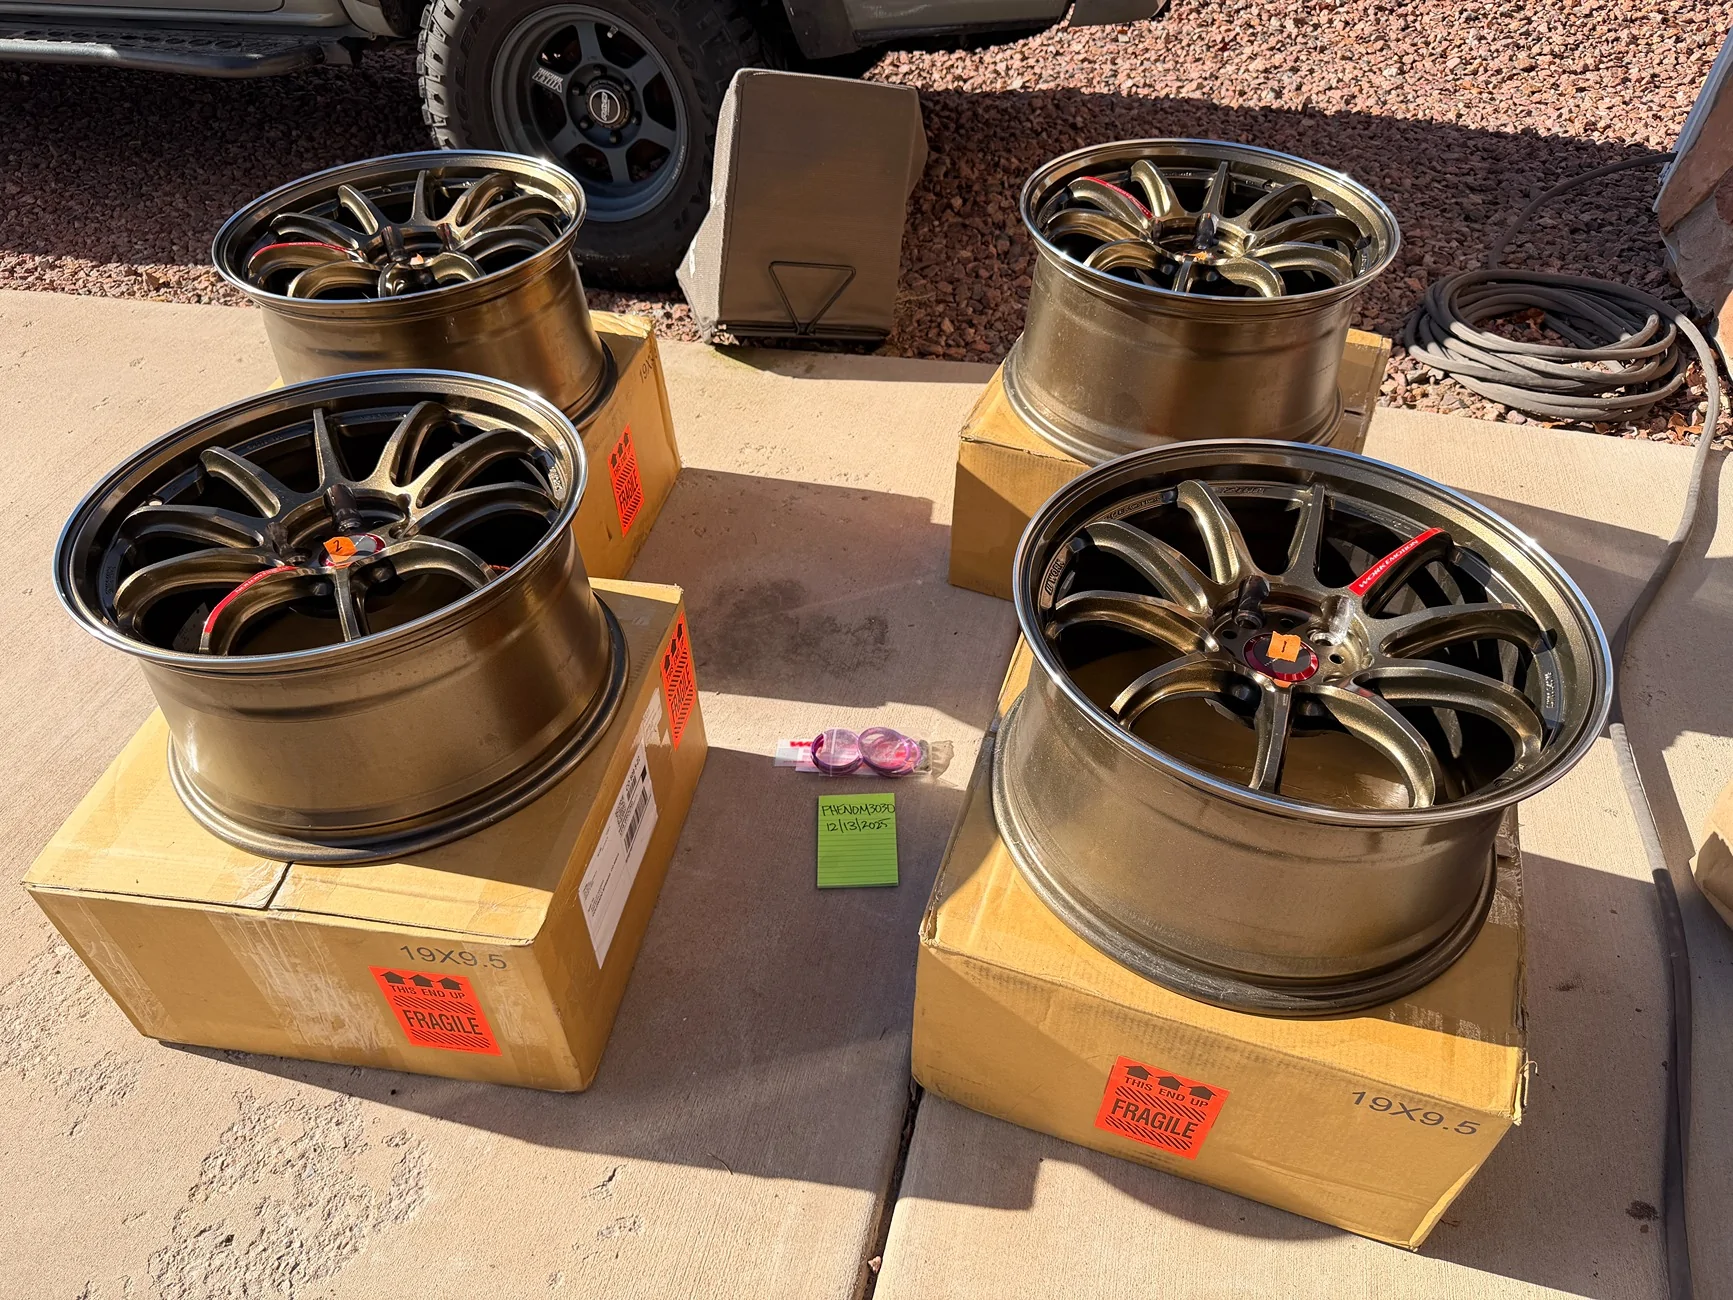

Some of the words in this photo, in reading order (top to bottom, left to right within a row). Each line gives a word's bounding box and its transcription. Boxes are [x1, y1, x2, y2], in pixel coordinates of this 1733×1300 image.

[332, 539, 343, 552] 2
[1358, 564, 1387, 588] WORK
[1385, 539, 1419, 566] EMOTION
[670, 663, 691, 724] FRAGILE
[821, 803, 896, 817] PHENOM3030
[826, 817, 891, 834] 12/13/2025
[400, 945, 507, 970] 19X9.5
[389, 985, 417, 995] THIS
[421, 988, 446, 998] END
[449, 991, 466, 1000] UP
[403, 1009, 483, 1035] FRAGILE
[1124, 1076, 1153, 1091] THIS
[1158, 1088, 1186, 1102] END
[1190, 1097, 1209, 1108] UP
[1111, 1097, 1199, 1139] FRAGILE
[1352, 1091, 1481, 1135] 19X9.5
